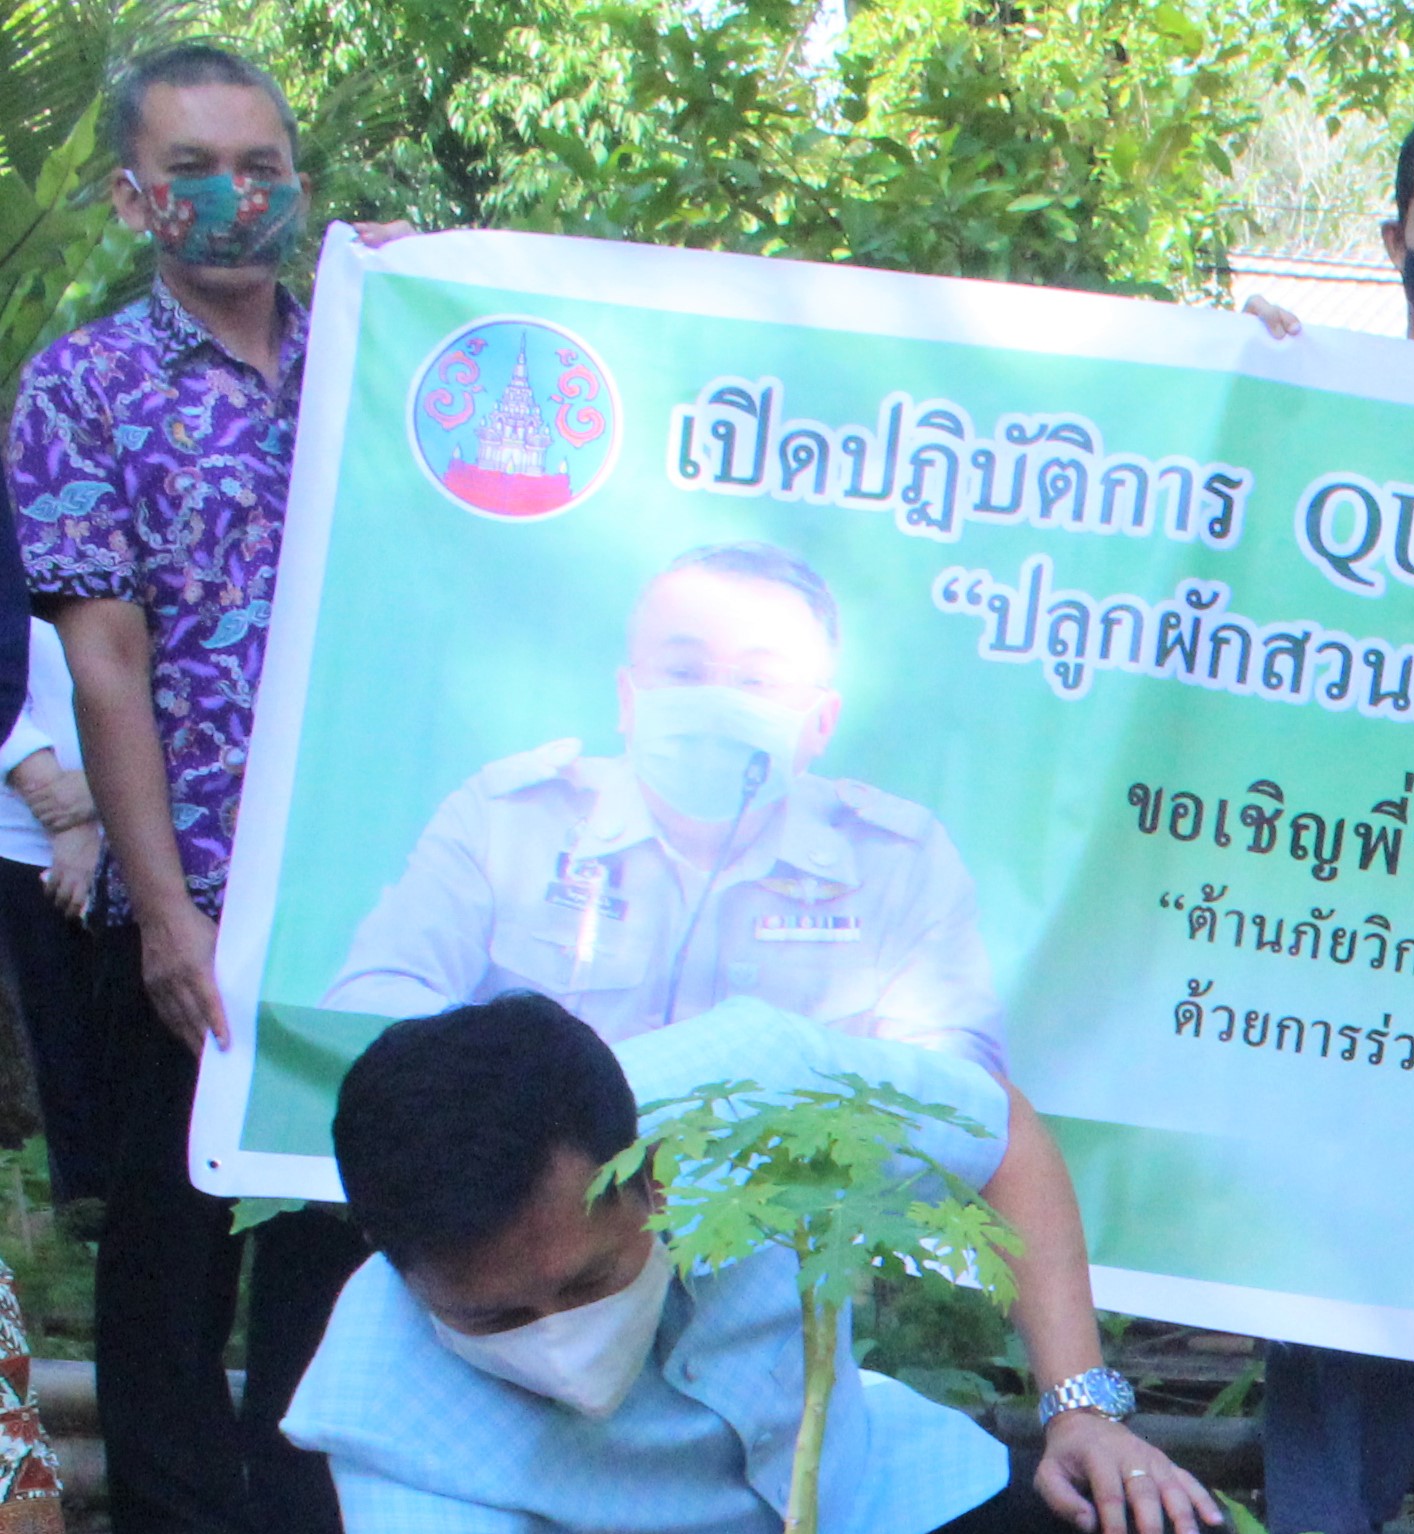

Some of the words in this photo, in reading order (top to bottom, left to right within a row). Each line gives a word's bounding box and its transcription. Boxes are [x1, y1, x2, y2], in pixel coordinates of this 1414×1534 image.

[677, 384, 1243, 541] เปิดปฏิบัติการ
